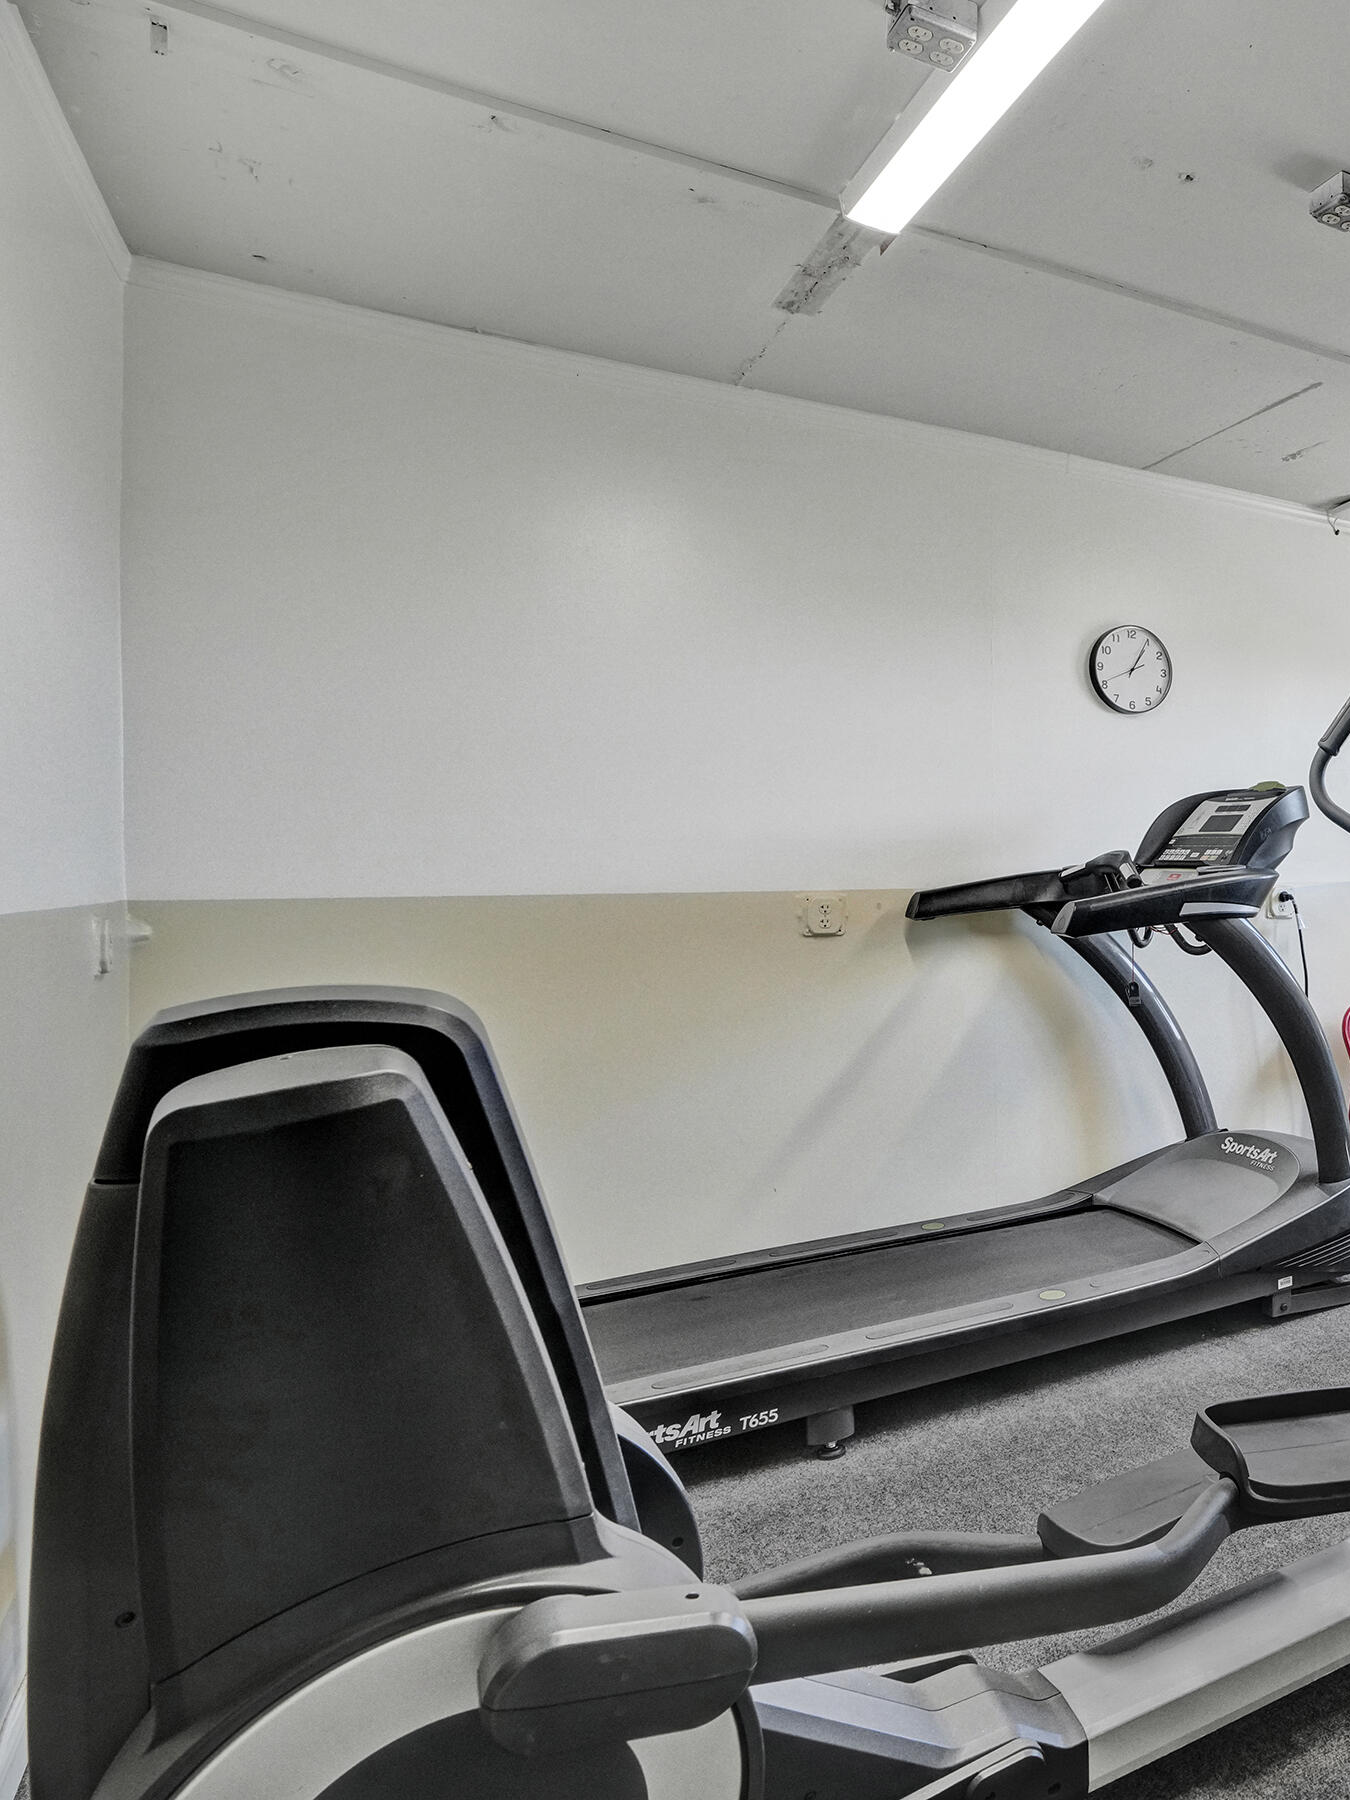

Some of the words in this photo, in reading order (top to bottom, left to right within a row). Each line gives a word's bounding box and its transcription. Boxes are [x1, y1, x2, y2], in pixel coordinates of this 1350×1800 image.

[1112, 634, 1120, 642] 11
[1127, 630, 1137, 639] 12
[1101, 646, 1111, 655] 10
[1156, 651, 1163, 660] 2
[1097, 662, 1104, 671] 9
[1160, 669, 1167, 678] 3
[1101, 680, 1108, 689] 8
[1156, 685, 1162, 694] 4
[1113, 693, 1120, 703] 7
[1145, 697, 1152, 706] 5
[1129, 701, 1136, 710] 6
[1221, 1136, 1278, 1164] SportsArt
[1250, 1159, 1275, 1172] FITNESS
[649, 1410, 722, 1443] tsArt
[739, 1408, 779, 1431] T655
[674, 1425, 731, 1448] FITNESS
